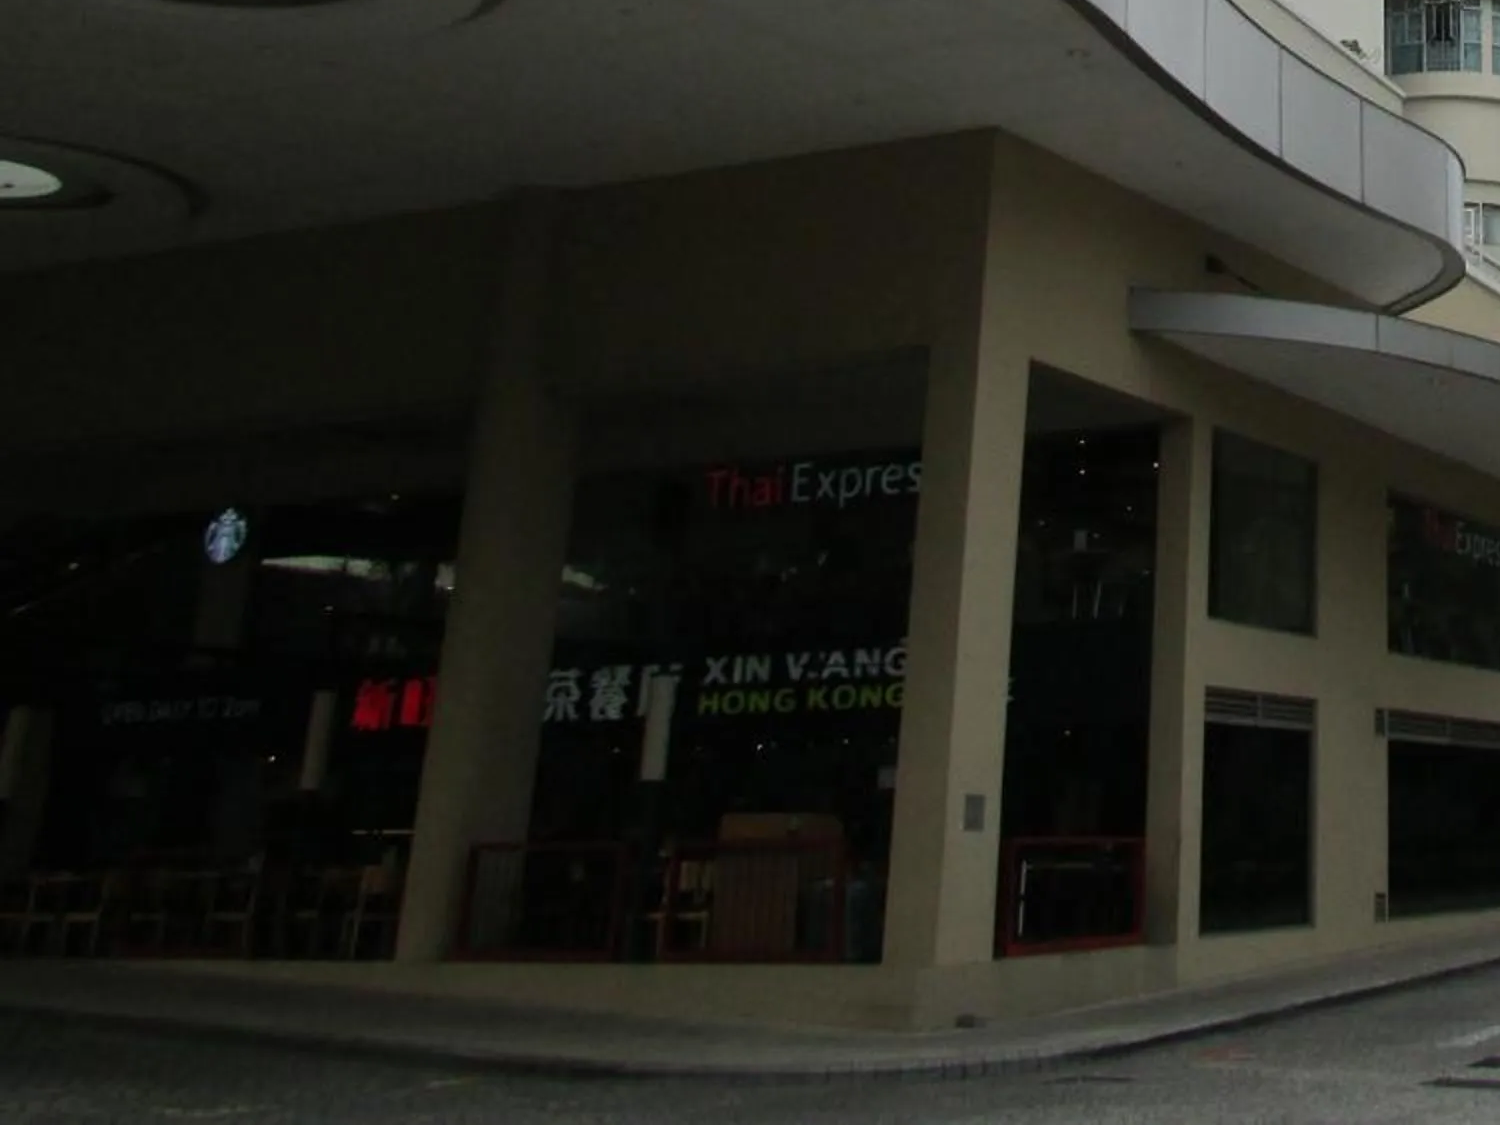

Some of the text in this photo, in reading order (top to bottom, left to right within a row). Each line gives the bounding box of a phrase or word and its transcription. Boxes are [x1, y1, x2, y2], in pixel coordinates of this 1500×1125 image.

[703, 654, 772, 686] XIN
[697, 682, 906, 716] HONG KONG
